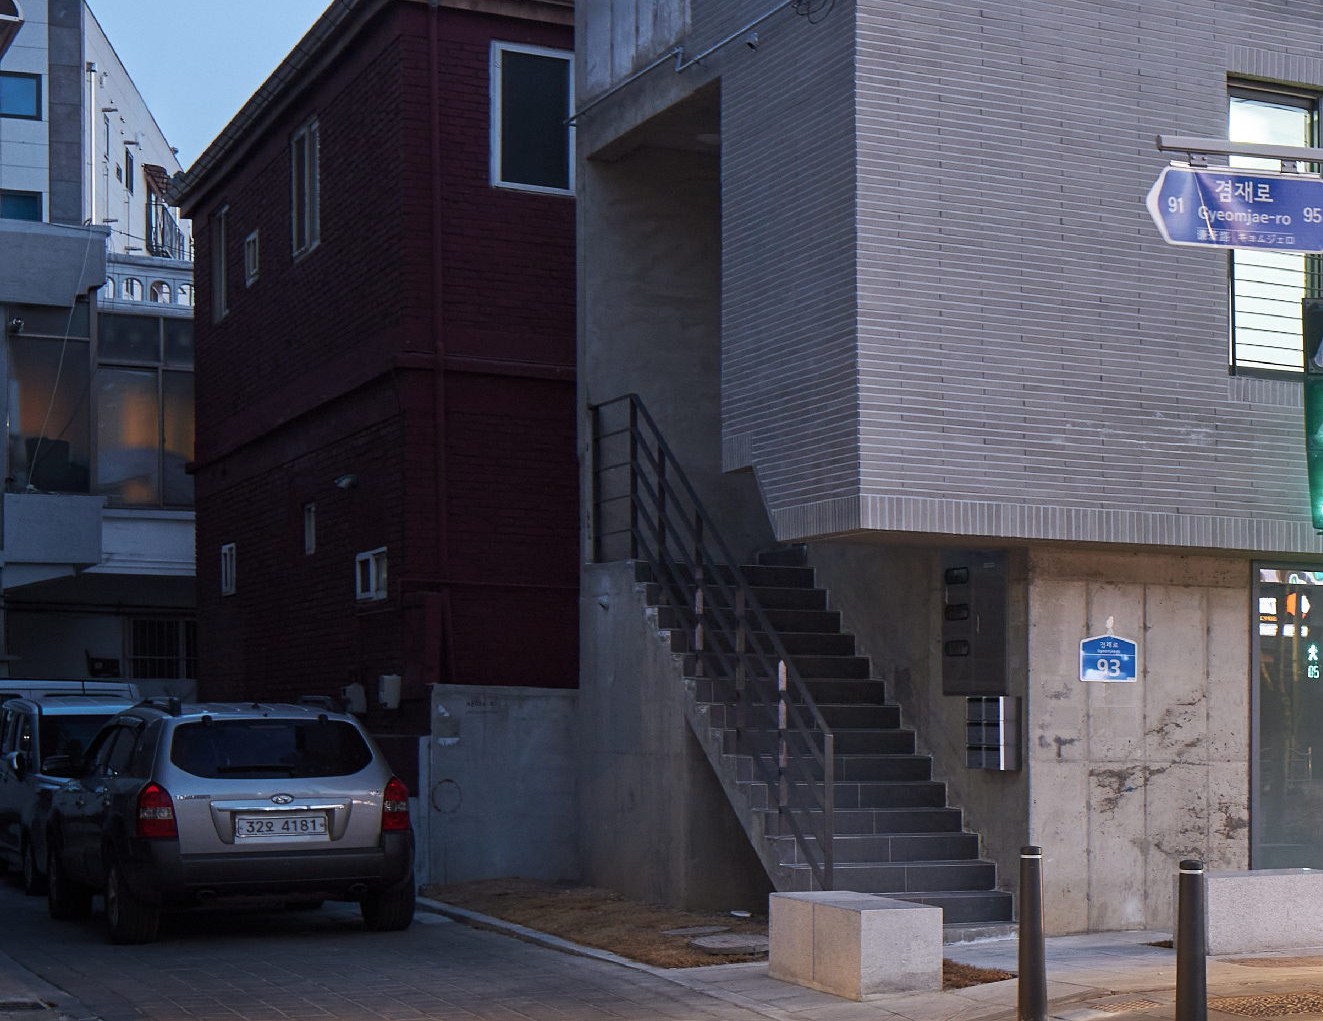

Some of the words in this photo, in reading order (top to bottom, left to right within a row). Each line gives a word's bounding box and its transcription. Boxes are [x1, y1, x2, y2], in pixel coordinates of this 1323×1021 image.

[1215, 180, 1274, 204] 겸재로
[1168, 196, 1185, 214] 91
[1198, 206, 1292, 226] Gyeomjae-ro
[1303, 207, 1323, 223] 95
[1097, 658, 1121, 677] 93
[281, 819, 317, 833] 4181
